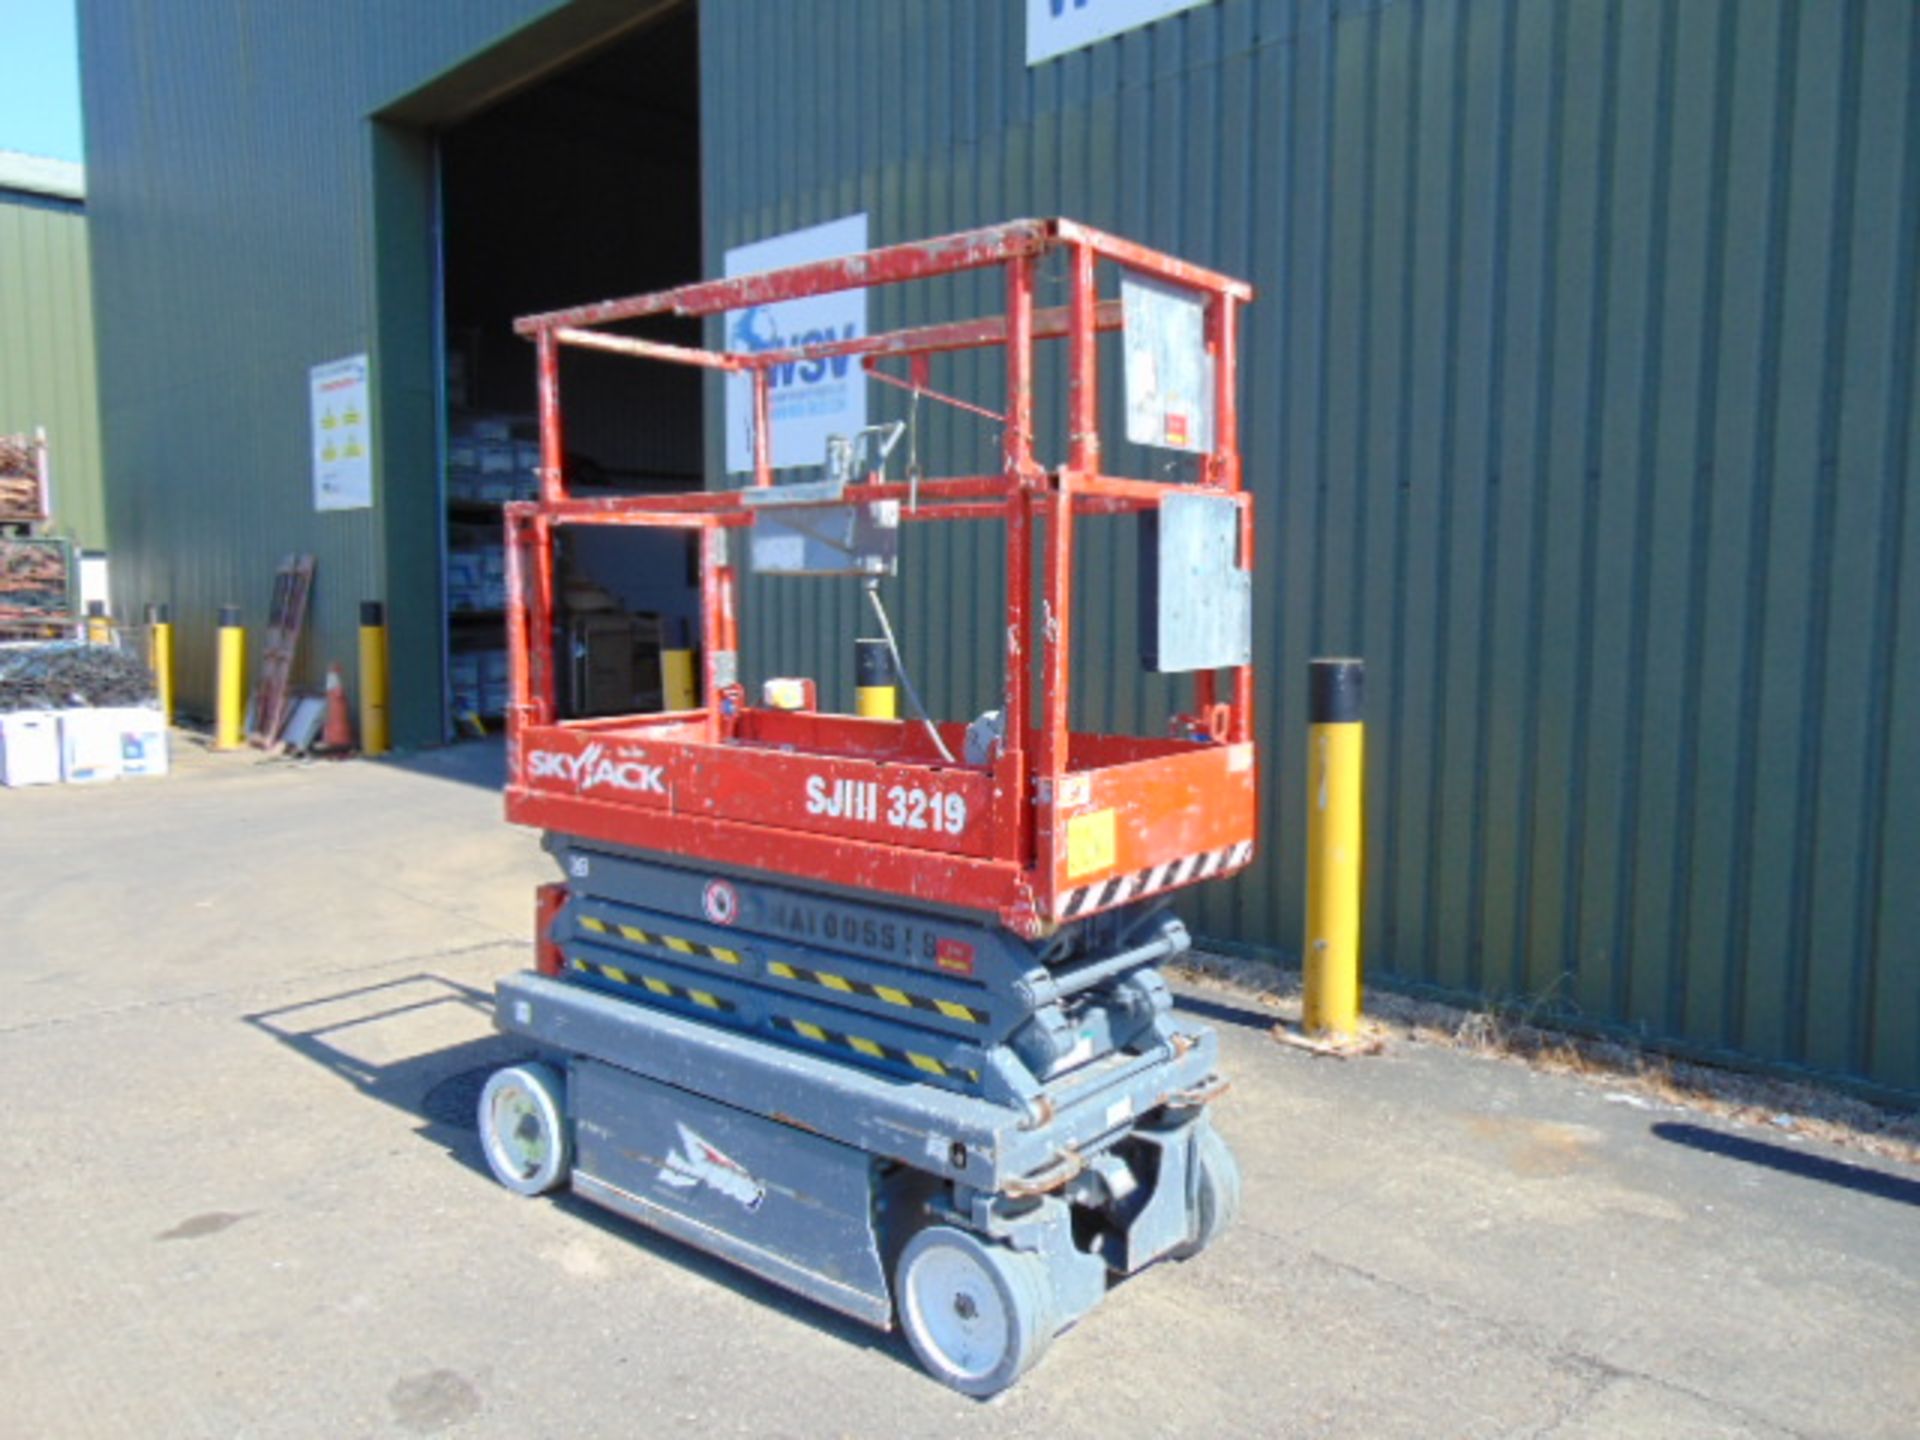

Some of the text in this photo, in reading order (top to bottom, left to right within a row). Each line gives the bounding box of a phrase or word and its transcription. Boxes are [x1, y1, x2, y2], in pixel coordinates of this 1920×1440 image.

[766, 322, 854, 388] WSV
[528, 741, 665, 793] SKYJACK
[805, 774, 967, 834] SJIII 3219
